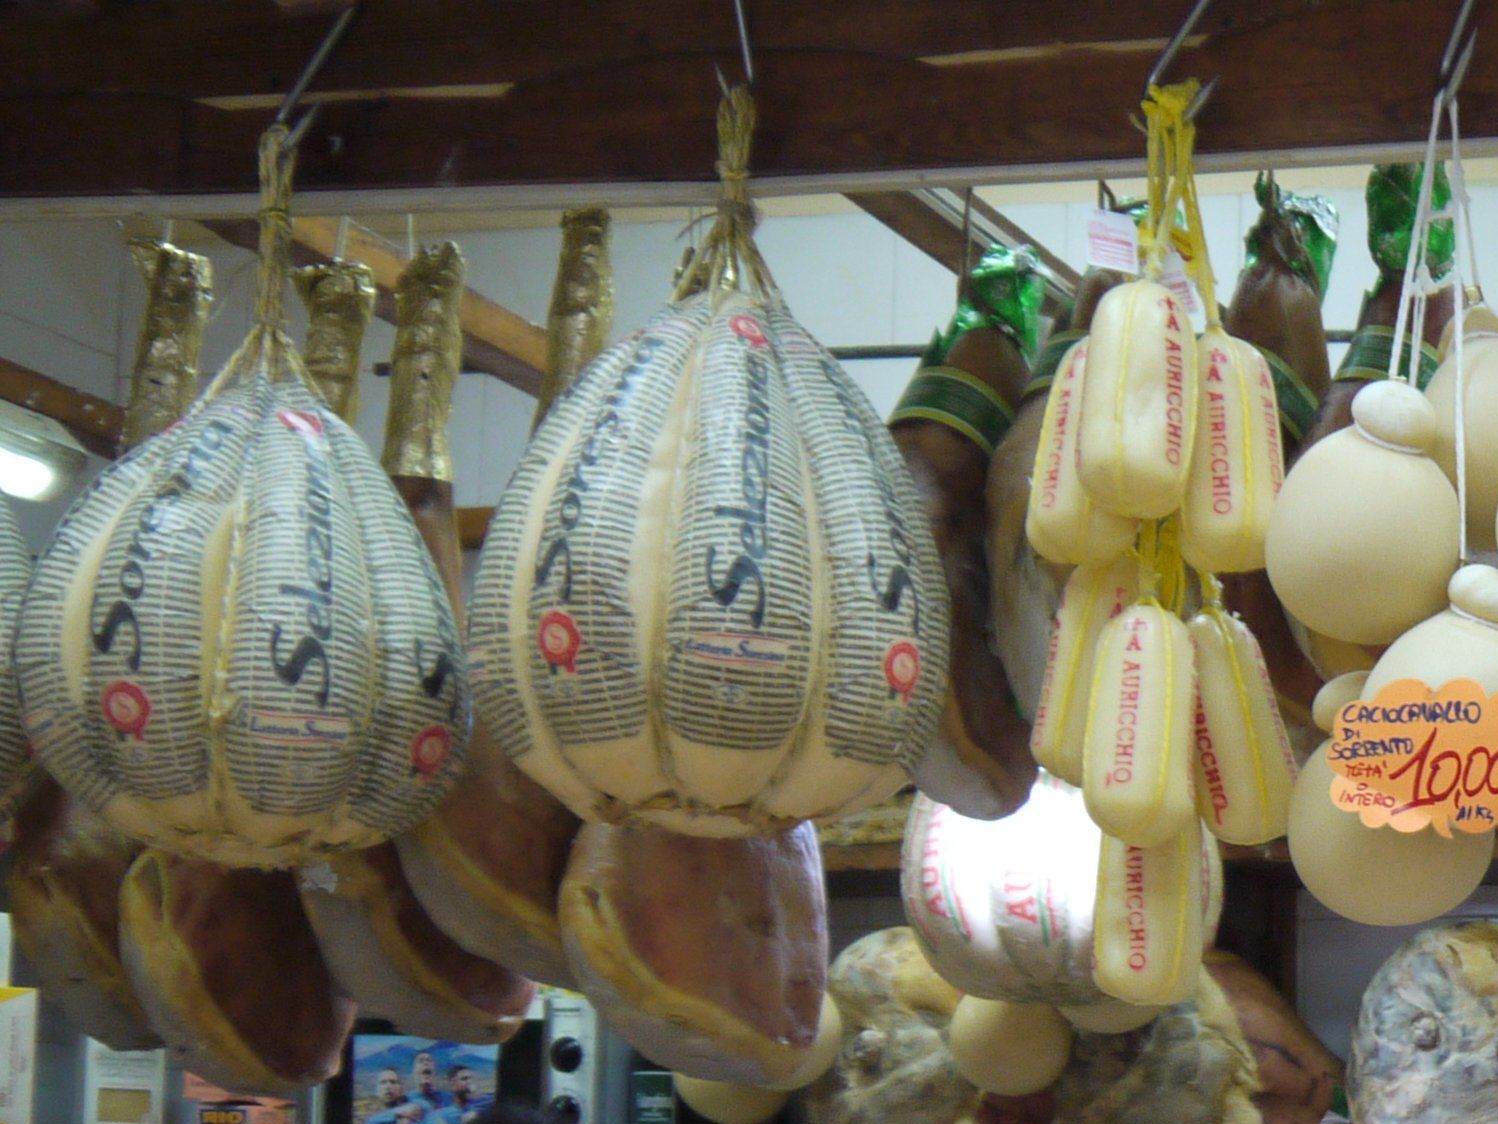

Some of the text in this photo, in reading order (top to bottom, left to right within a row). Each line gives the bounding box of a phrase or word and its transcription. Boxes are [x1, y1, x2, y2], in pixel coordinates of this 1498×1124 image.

[1165, 339, 1184, 466] AURICCHIO
[705, 351, 772, 629] Selezione
[1208, 391, 1233, 515] AURICCHIO
[1113, 660, 1141, 786] AURICCHIO
[1328, 737, 1414, 760] SORRENTO
[1342, 700, 1482, 725] CACIOCAVALLO
[1339, 790, 1396, 809] INTERO
[202, 1111, 244, 1124] RIO
